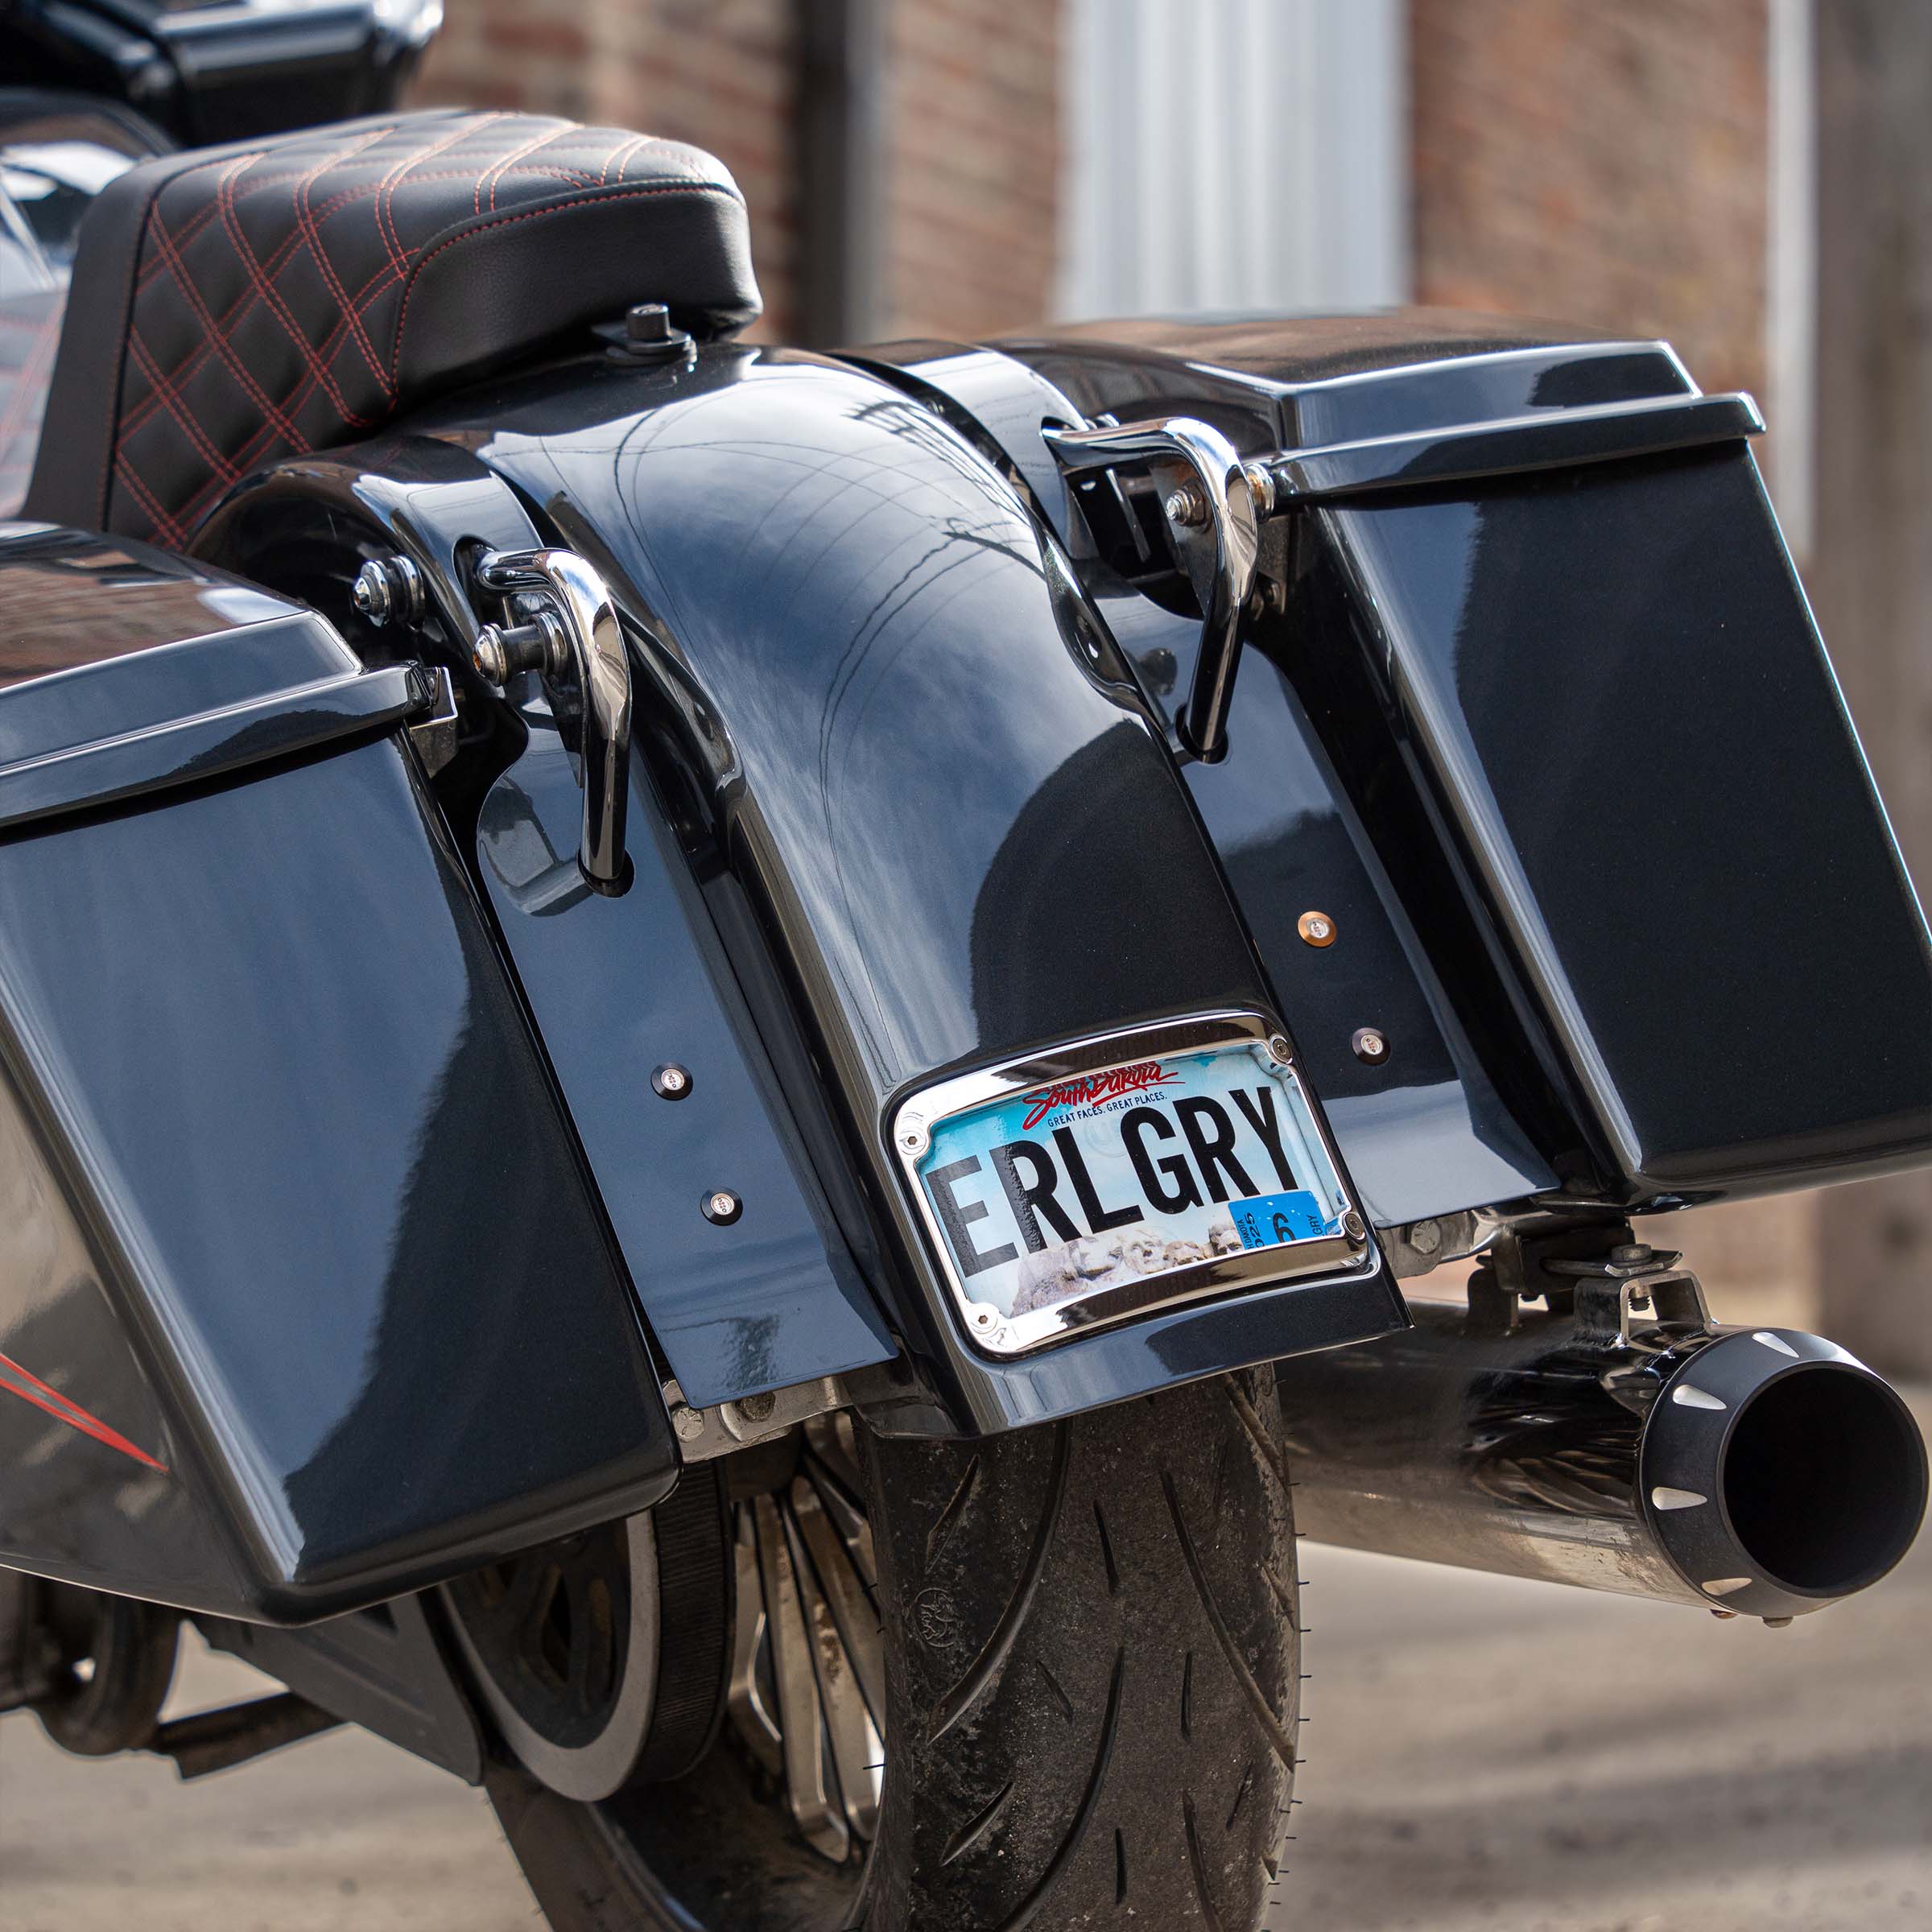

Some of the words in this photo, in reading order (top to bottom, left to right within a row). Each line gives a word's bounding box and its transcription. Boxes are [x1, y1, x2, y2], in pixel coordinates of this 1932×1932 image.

[1047, 1113, 1076, 1127] GREAT
[1078, 1106, 1105, 1120] FACES.
[1107, 1098, 1133, 1112] GREAT
[1136, 1092, 1167, 1105] PLACES.
[925, 1086, 1299, 1278] ERLGRY
[1244, 1212, 1265, 1248] 025
